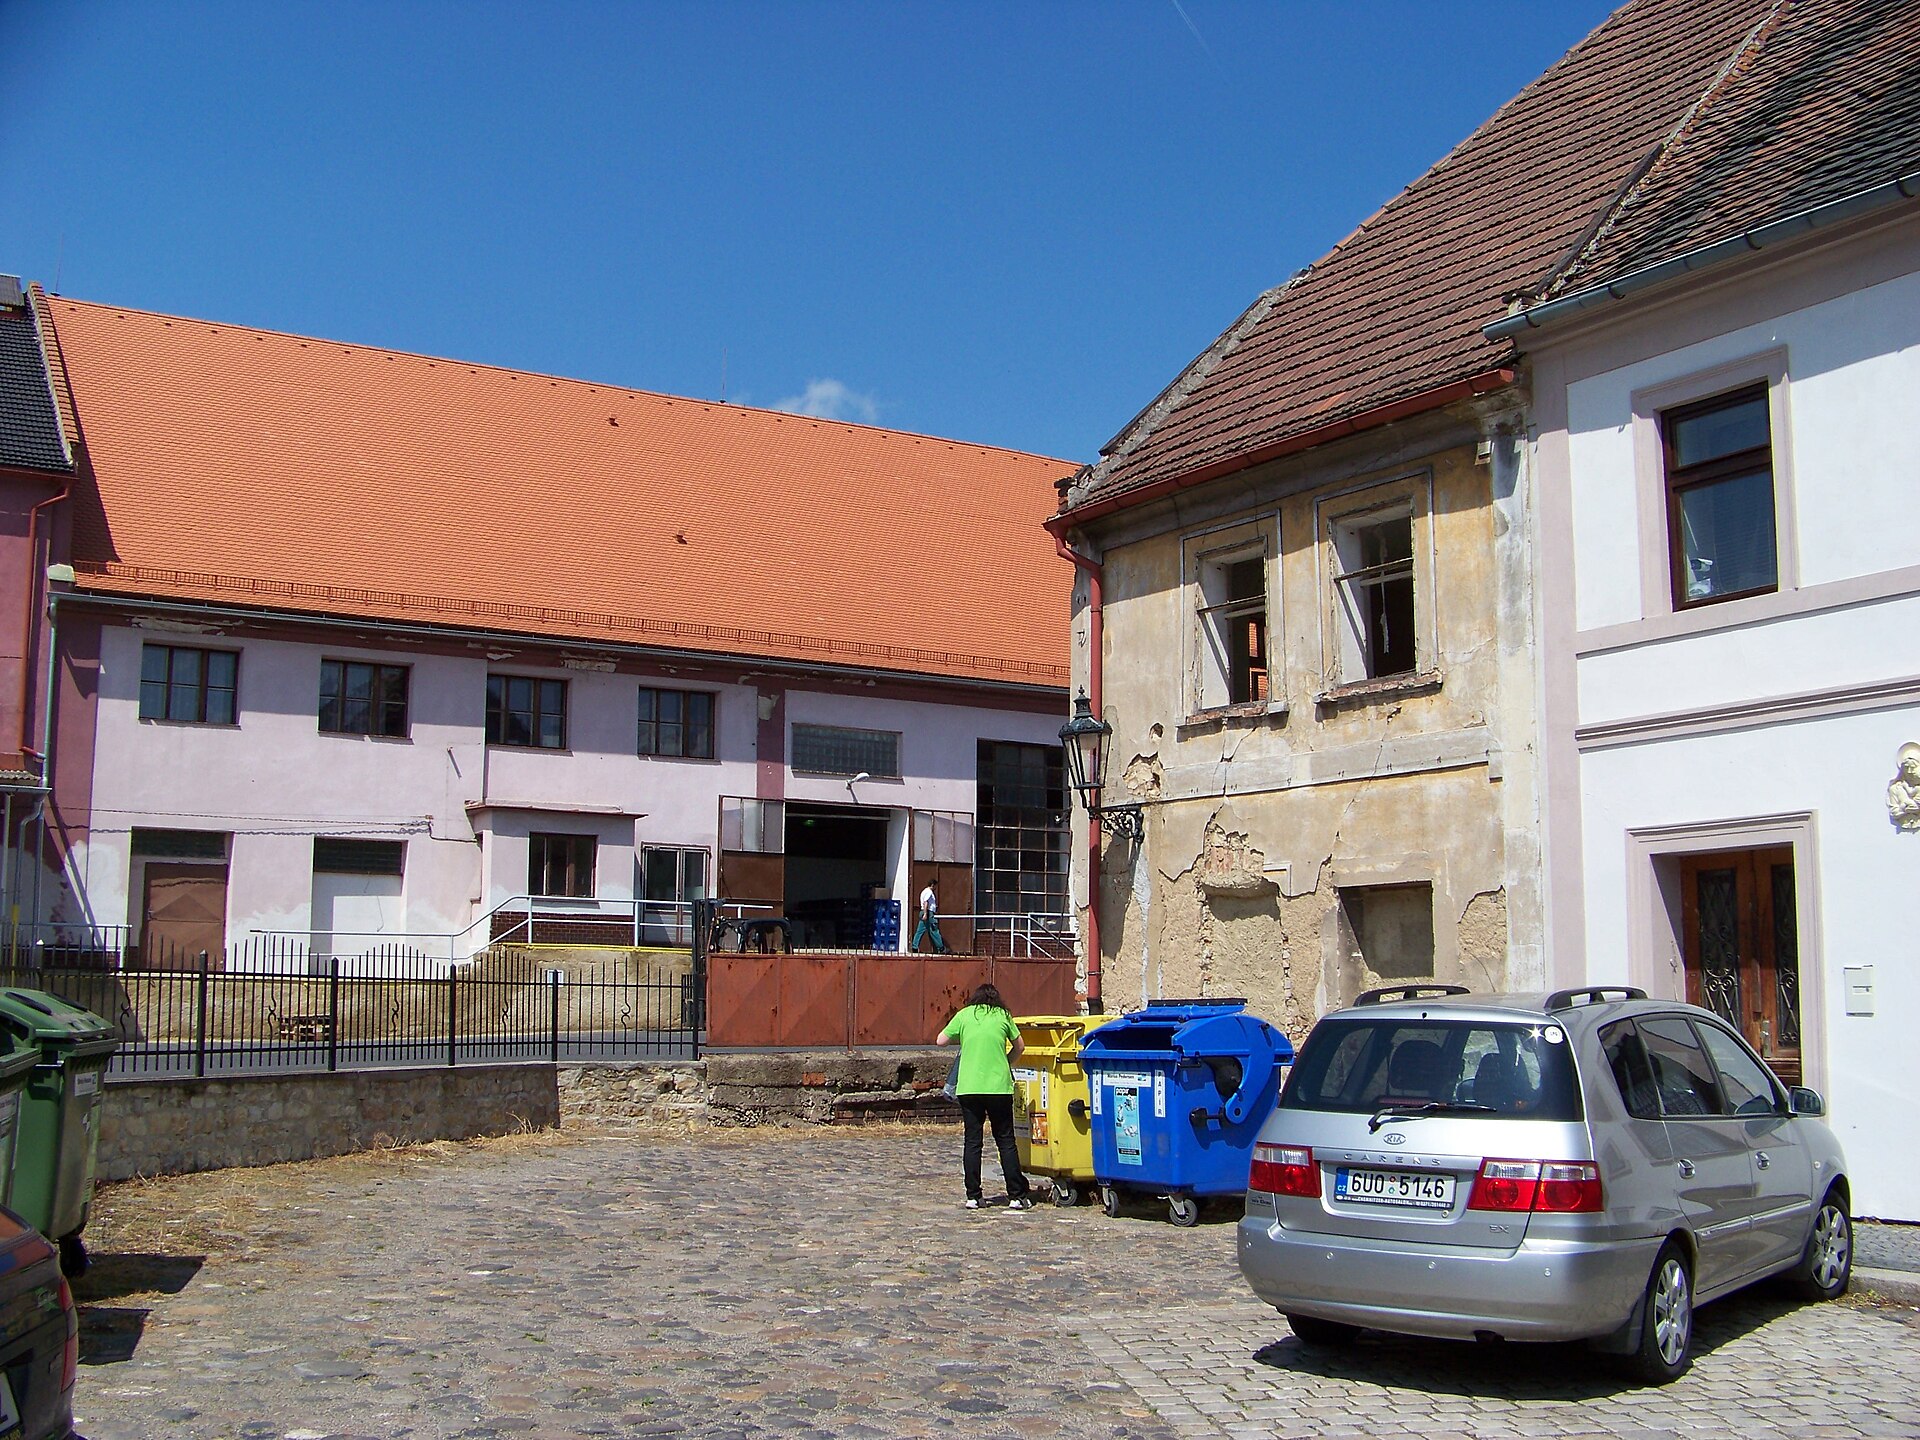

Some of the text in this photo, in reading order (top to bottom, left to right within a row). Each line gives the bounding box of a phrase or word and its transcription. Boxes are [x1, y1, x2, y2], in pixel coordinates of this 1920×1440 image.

[1343, 1153, 1441, 1166] CARENS
[1399, 1175, 1446, 1198] 5146
[1489, 1223, 1510, 1234] EX
